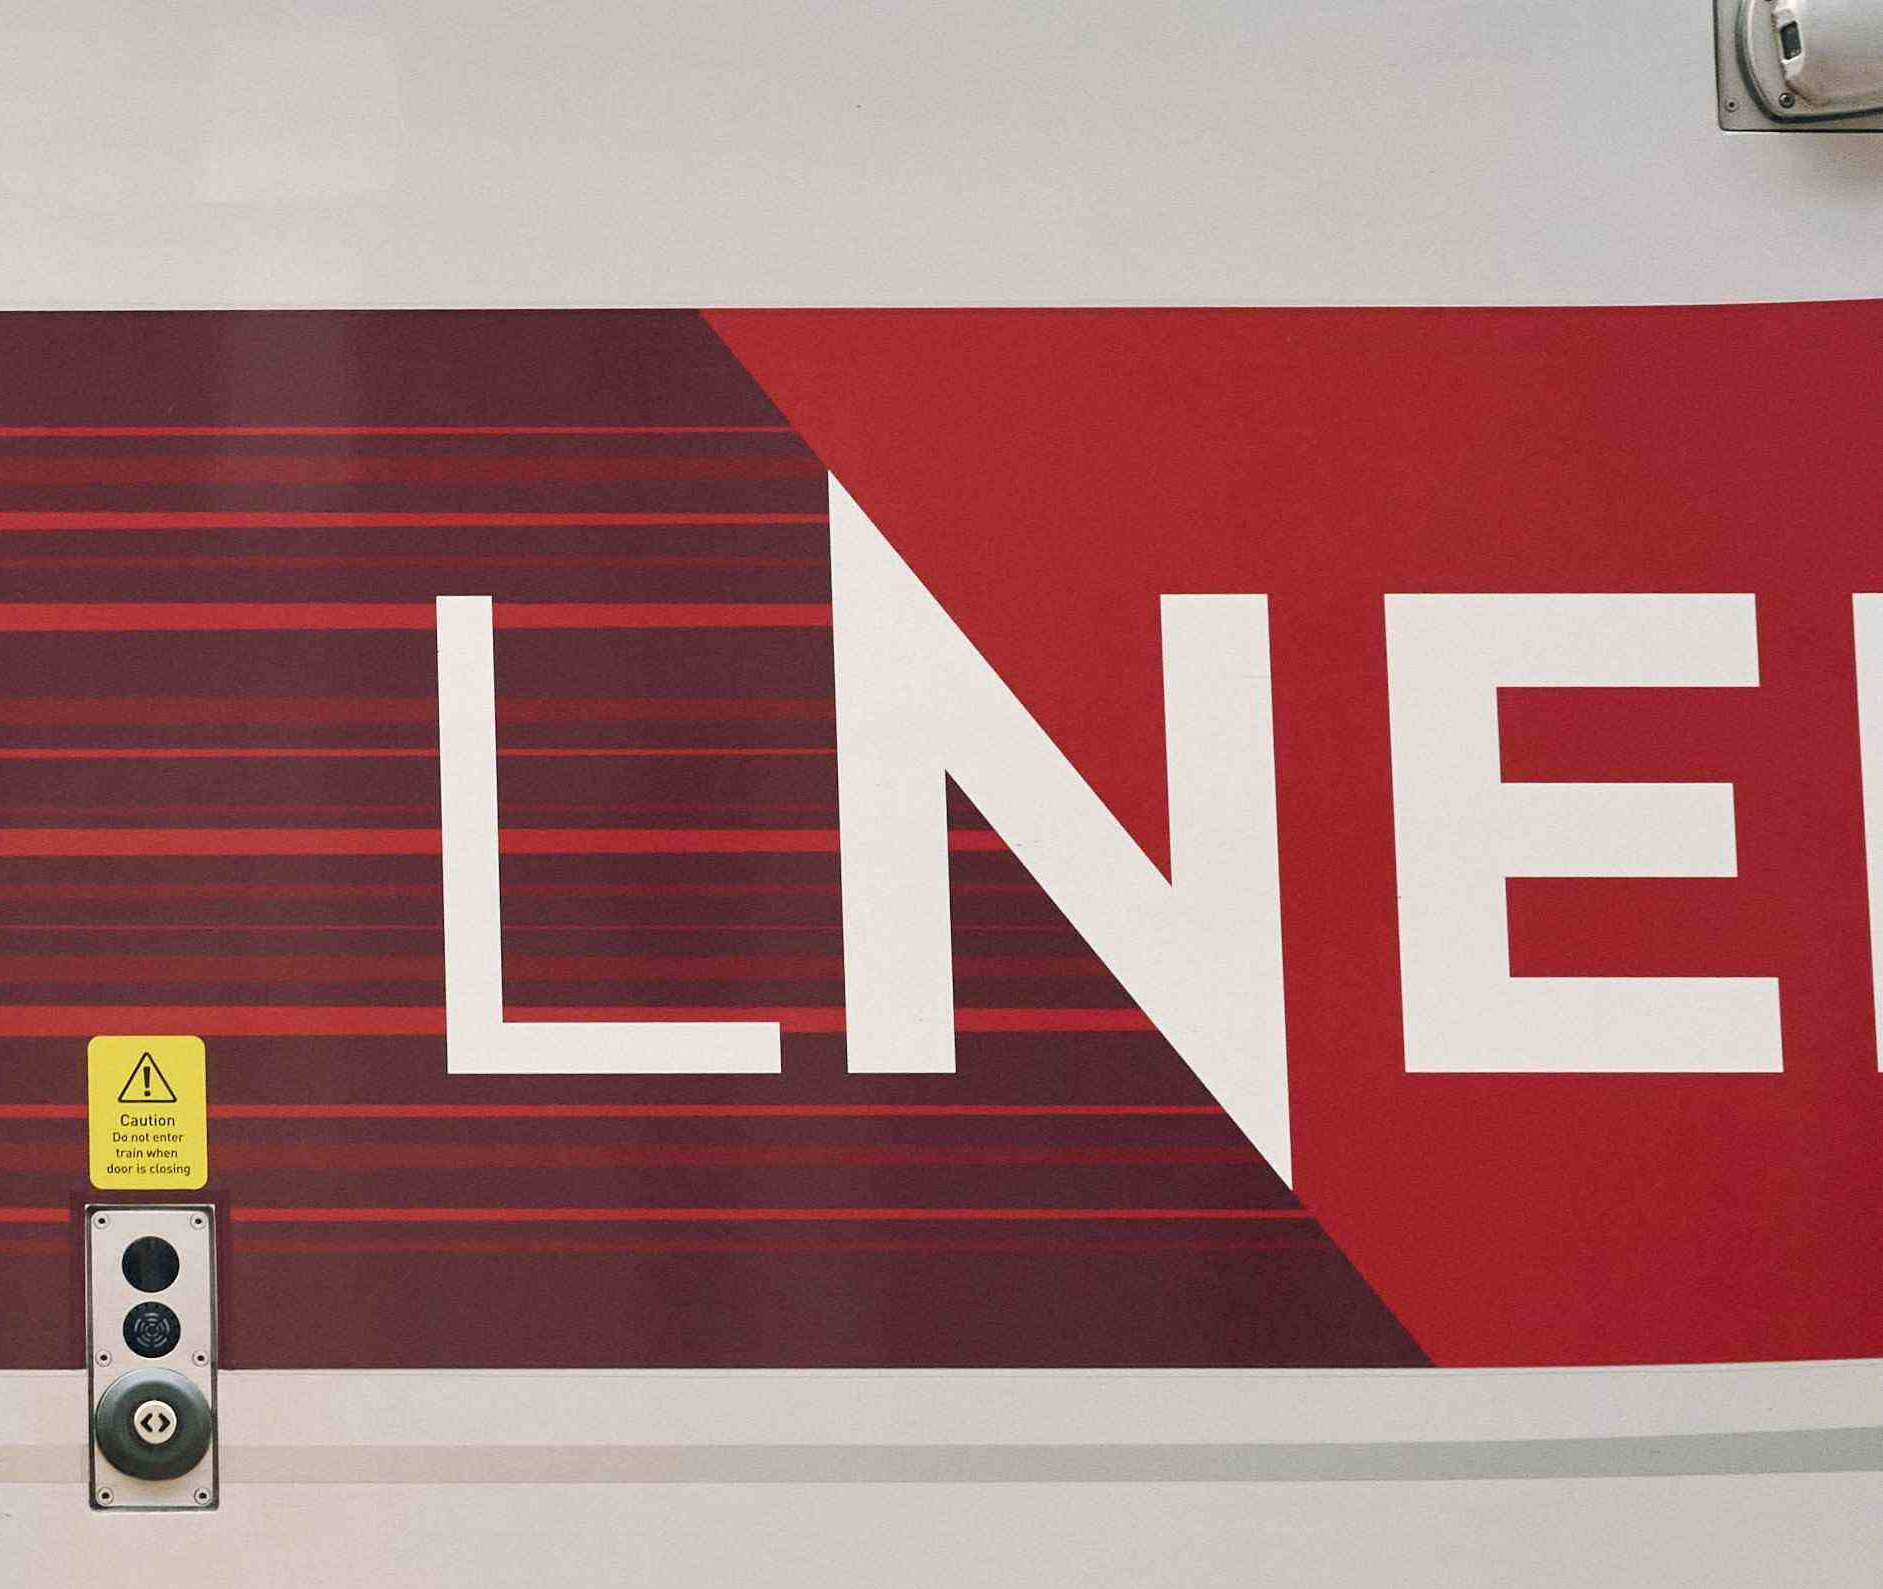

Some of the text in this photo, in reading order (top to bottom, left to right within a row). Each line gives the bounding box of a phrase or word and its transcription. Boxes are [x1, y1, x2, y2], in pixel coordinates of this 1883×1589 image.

[436, 470, 1883, 1191] LNE
[120, 1113, 176, 1127] Caution
[113, 1131, 185, 1143] Do not enter
[116, 1148, 178, 1158] train when
[107, 1164, 191, 1177] door is closing
